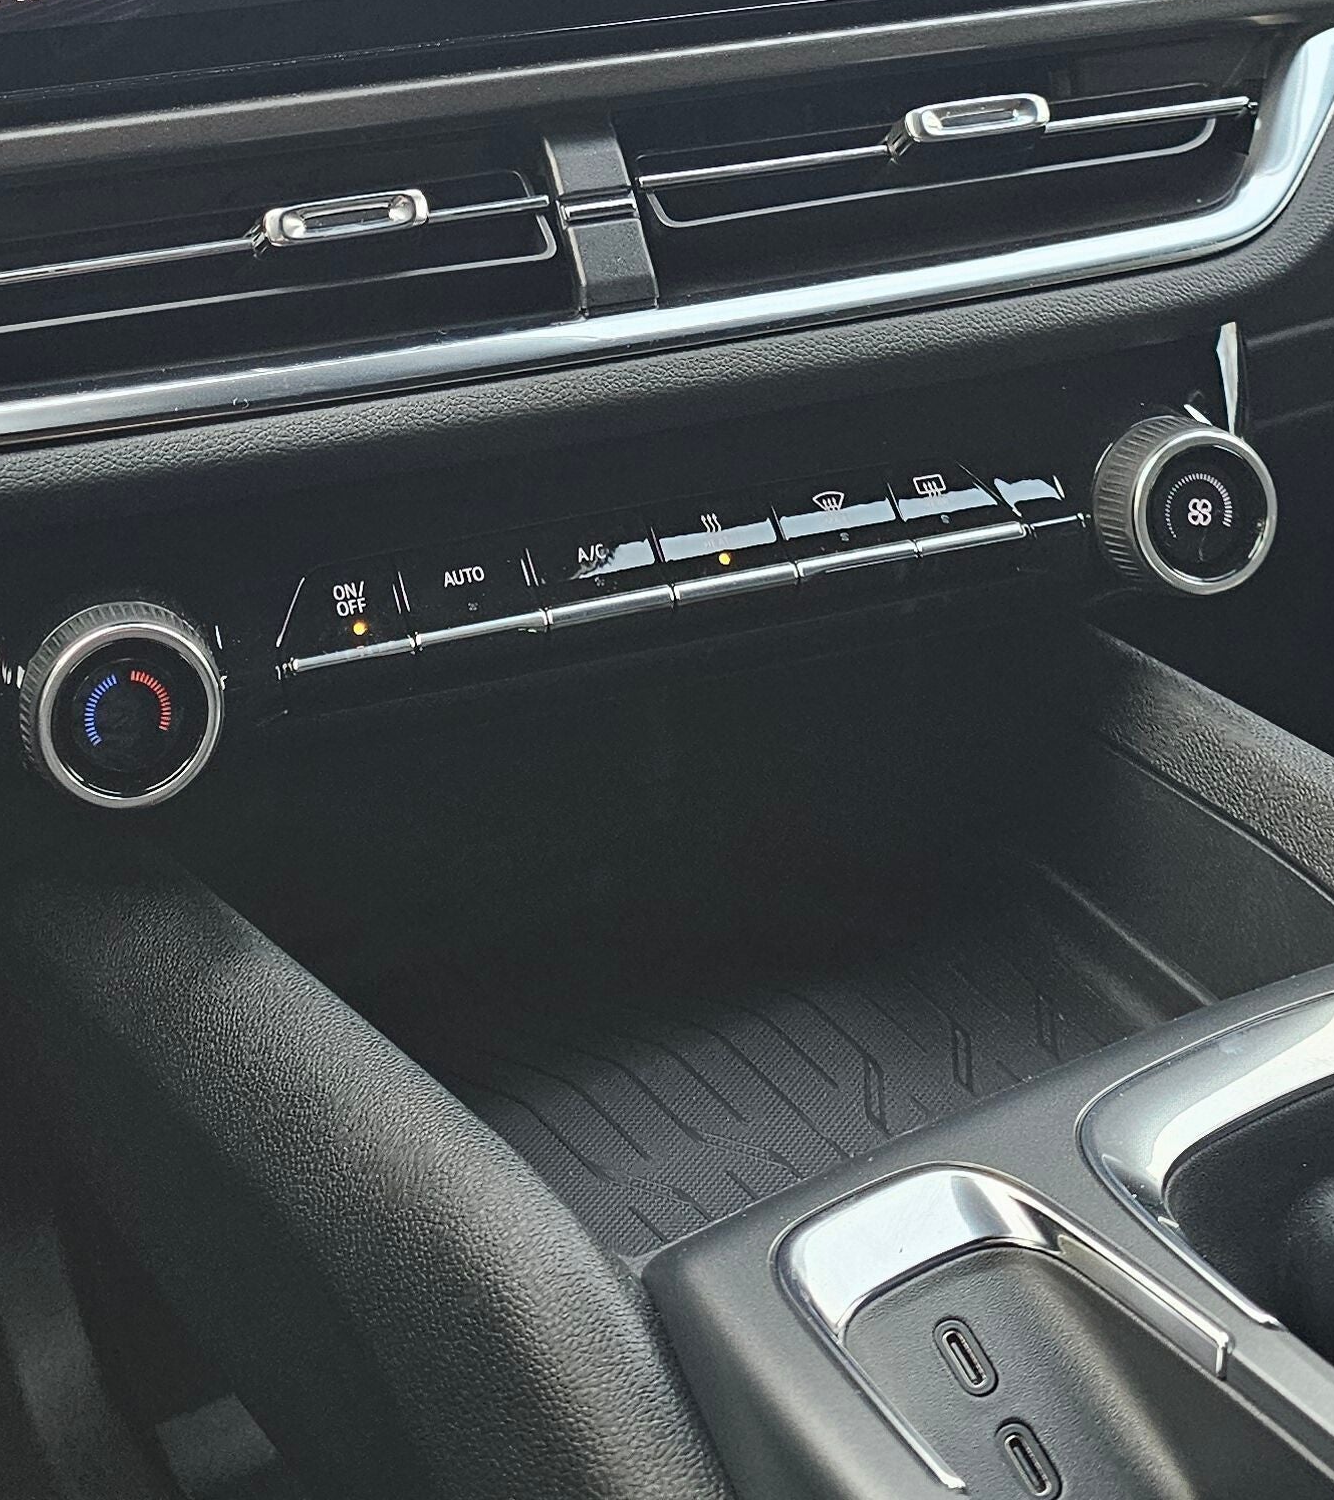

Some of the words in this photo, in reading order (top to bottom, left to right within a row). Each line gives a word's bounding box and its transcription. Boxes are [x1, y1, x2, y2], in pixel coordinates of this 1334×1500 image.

[577, 543, 608, 563] A/C
[443, 565, 485, 588] AUTO
[332, 581, 365, 601] ON/
[335, 598, 367, 617] OFF
